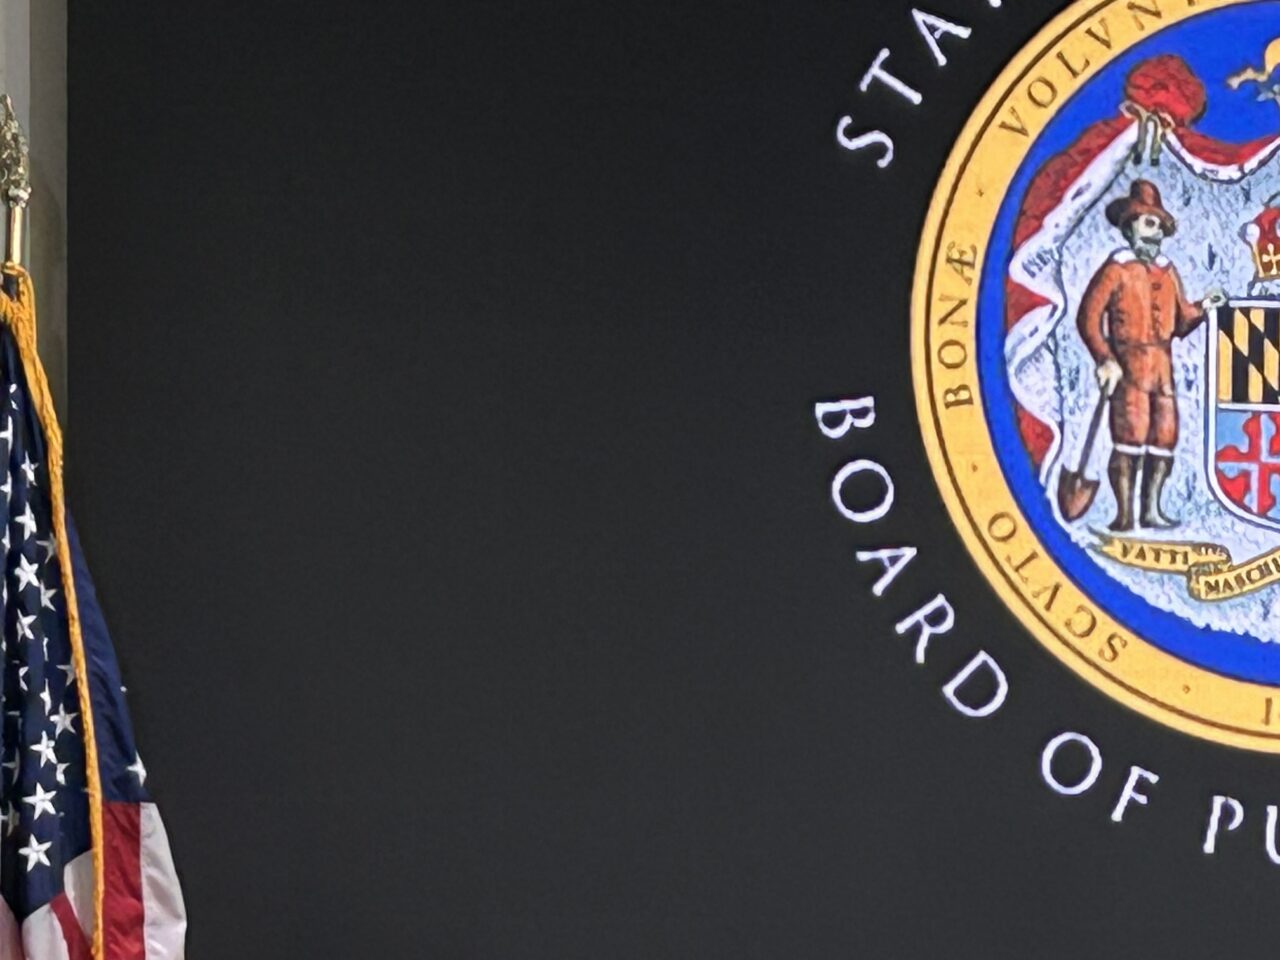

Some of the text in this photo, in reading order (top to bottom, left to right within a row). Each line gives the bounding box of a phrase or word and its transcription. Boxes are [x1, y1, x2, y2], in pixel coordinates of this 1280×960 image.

[836, 0, 1002, 168] STA
[937, 240, 979, 410] BONÆ
[999, 0, 1196, 141] VOLVN
[814, 395, 1009, 718] BOARD
[1040, 731, 1160, 823] OF
